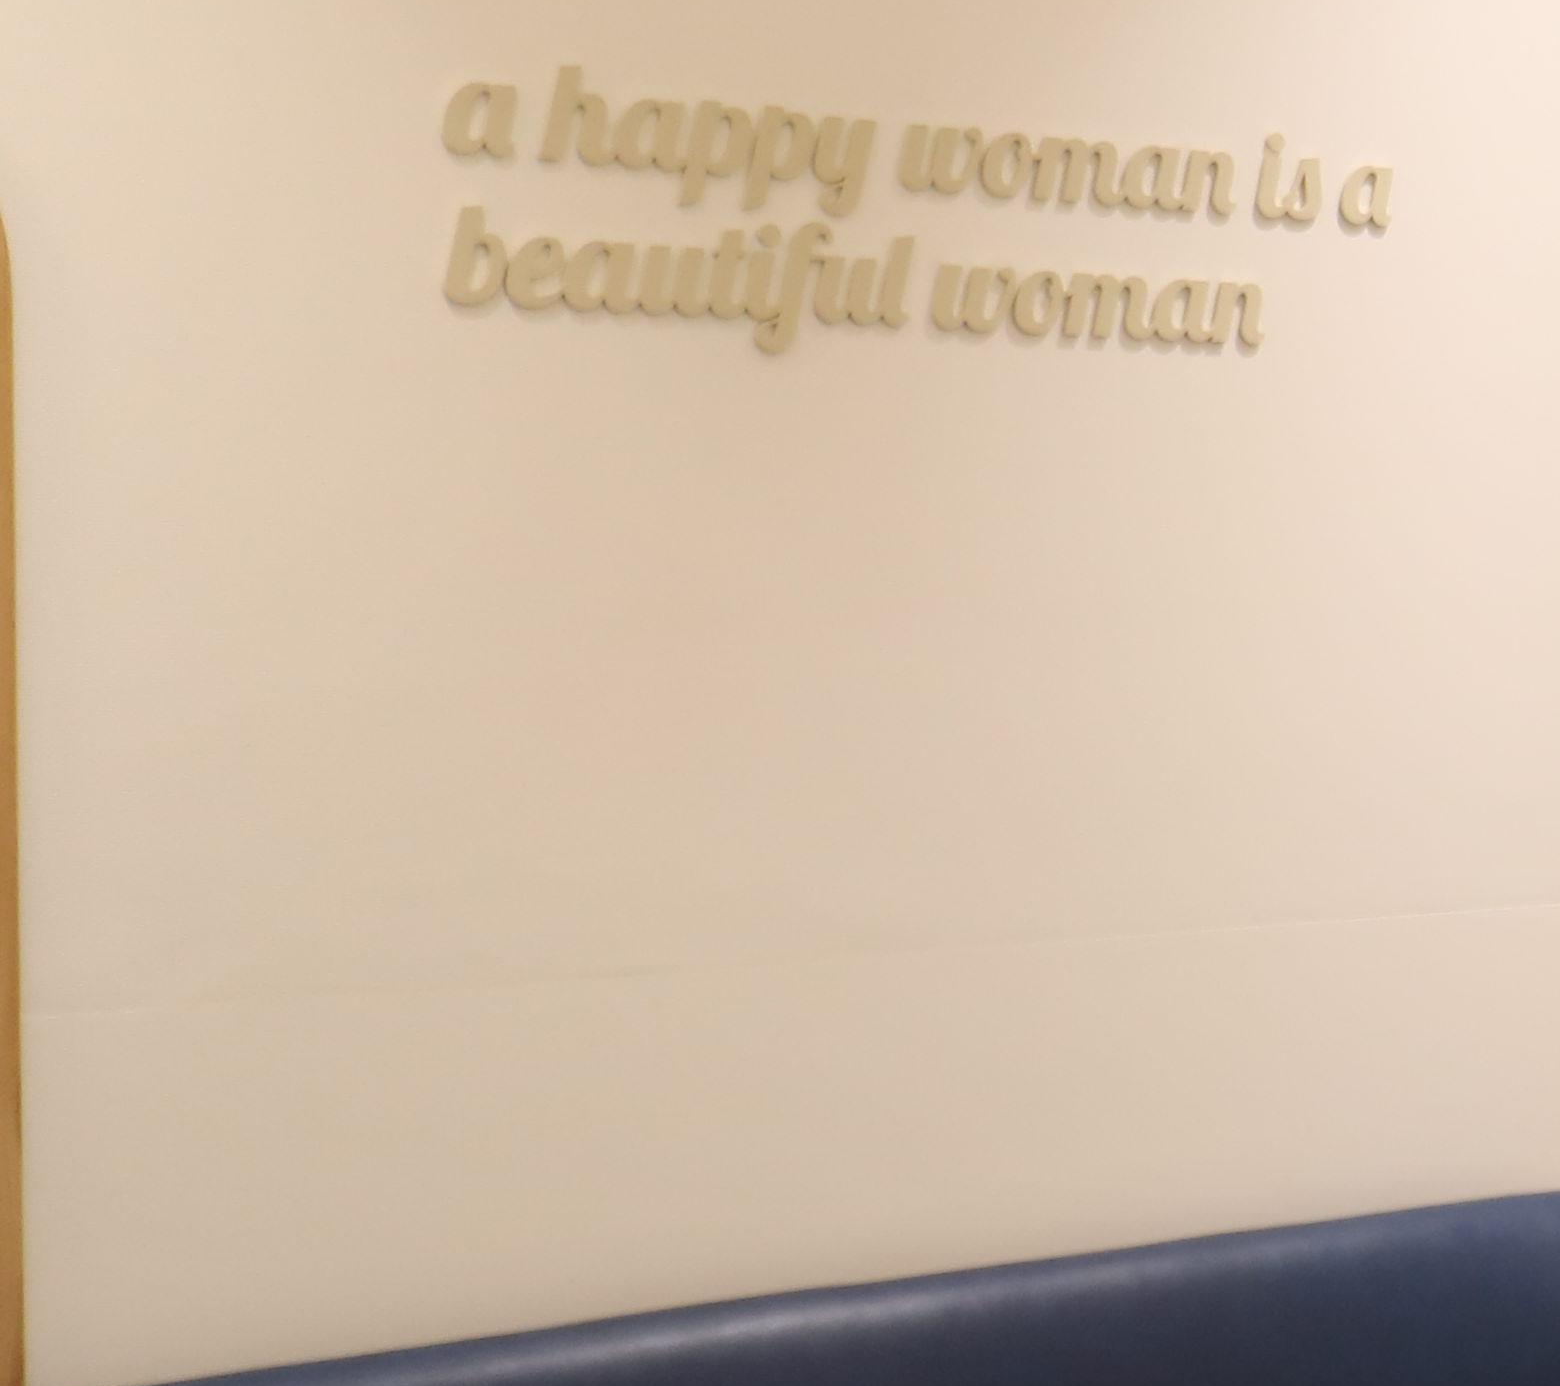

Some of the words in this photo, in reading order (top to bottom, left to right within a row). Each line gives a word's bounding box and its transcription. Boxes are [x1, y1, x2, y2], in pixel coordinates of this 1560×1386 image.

[441, 80, 517, 158] a
[537, 65, 877, 213] happy
[897, 121, 1236, 215] woman
[1254, 131, 1325, 221] is
[1338, 163, 1396, 228] a
[444, 204, 917, 355] beautiful
[928, 258, 1265, 348] woman
